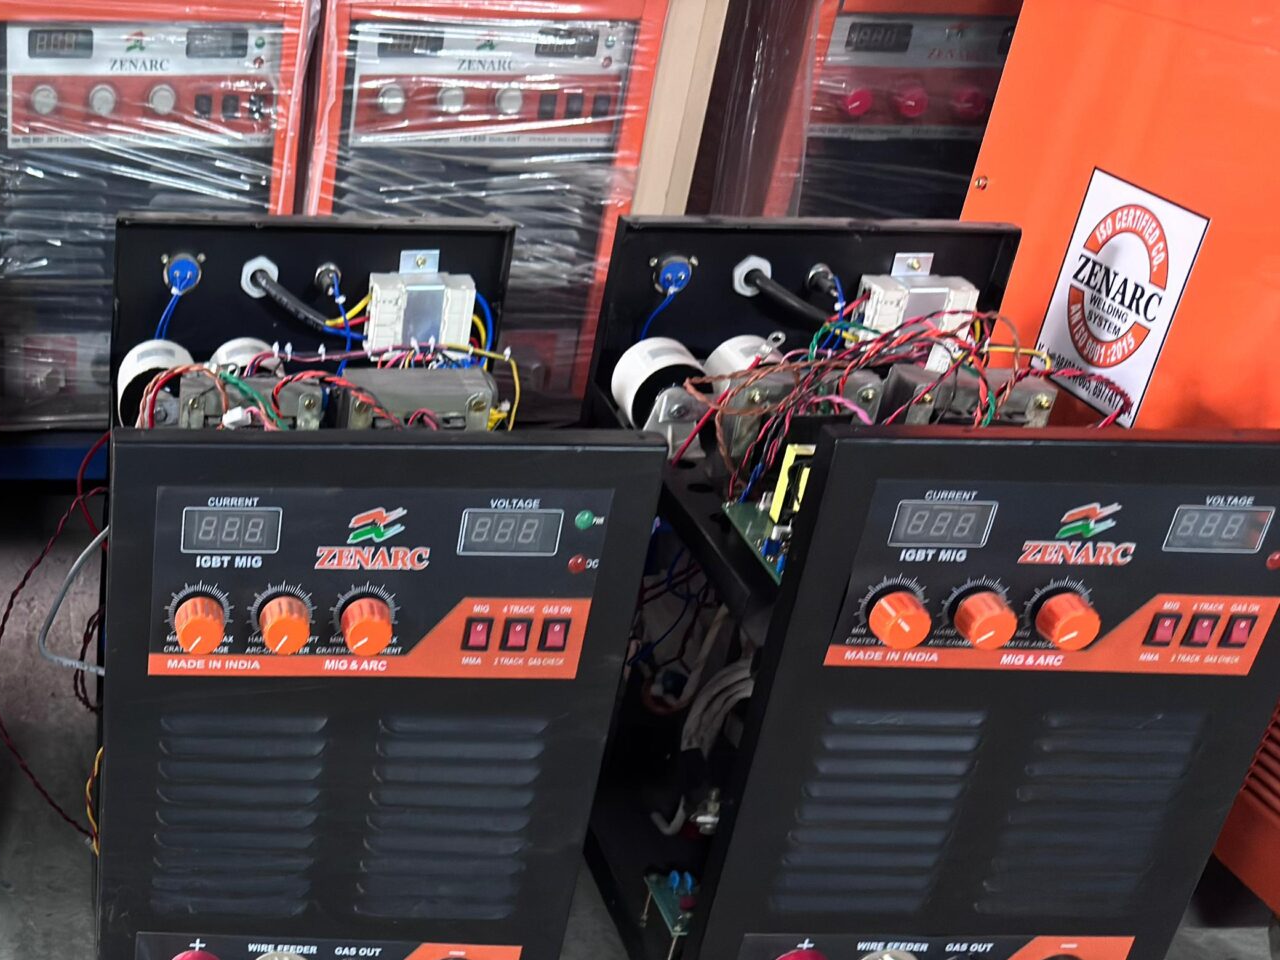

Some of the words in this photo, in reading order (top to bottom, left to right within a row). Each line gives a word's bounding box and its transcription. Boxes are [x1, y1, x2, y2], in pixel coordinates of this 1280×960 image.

[110, 58, 170, 72] ZENARC
[457, 58, 517, 72] ZENARC
[1095, 216, 1113, 244] ISO
[1115, 208, 1160, 242] CERTIFIED
[1151, 239, 1166, 272] CO.
[1072, 254, 1163, 322] ZENARC
[1090, 292, 1128, 323] WELDING
[1086, 310, 1121, 338] SYSTEM
[1073, 318, 1087, 345] ISO
[924, 490, 978, 500] CURRENT
[1206, 495, 1255, 506] VOLTAGE
[208, 496, 259, 507] CURRENT
[490, 498, 541, 509] VOLTAGE
[314, 546, 430, 571] ZENARC
[900, 550, 936, 562] IGBT
[938, 550, 968, 562] MIG
[1017, 540, 1137, 566] ZENARC
[196, 556, 229, 568] IGBT
[235, 556, 262, 568] MIG
[472, 604, 490, 614] MIG
[509, 605, 536, 614] TRACK
[542, 605, 558, 614] GAS
[560, 606, 572, 614] ON
[1163, 601, 1180, 610] MIG
[1199, 602, 1224, 611] TRACK
[1230, 603, 1246, 612] GAS
[1247, 604, 1260, 612] ON
[462, 657, 482, 665] MMA
[844, 650, 883, 660] MADE
[886, 652, 900, 661] IN
[902, 652, 938, 662] INDIA
[1000, 654, 1025, 664] MIG
[1025, 654, 1035, 665] &
[1035, 654, 1064, 665] ARC
[1139, 653, 1160, 662] MMA
[1176, 654, 1200, 663] TRACK
[166, 660, 205, 669] MADE
[208, 660, 222, 669] IN
[224, 660, 260, 670] INDIA
[324, 660, 348, 670] MIG
[348, 660, 359, 670] &
[359, 660, 388, 672] ARC
[500, 658, 524, 666] TRACK
[528, 658, 542, 666] GAS
[248, 943, 274, 952] WIRE
[277, 944, 318, 954] FEEDER
[334, 946, 356, 956] GAS
[358, 948, 382, 956] OUT
[856, 942, 886, 951] WIRE
[886, 942, 929, 952] FEEDER
[945, 942, 968, 952] GAS
[970, 943, 994, 952] OUT
